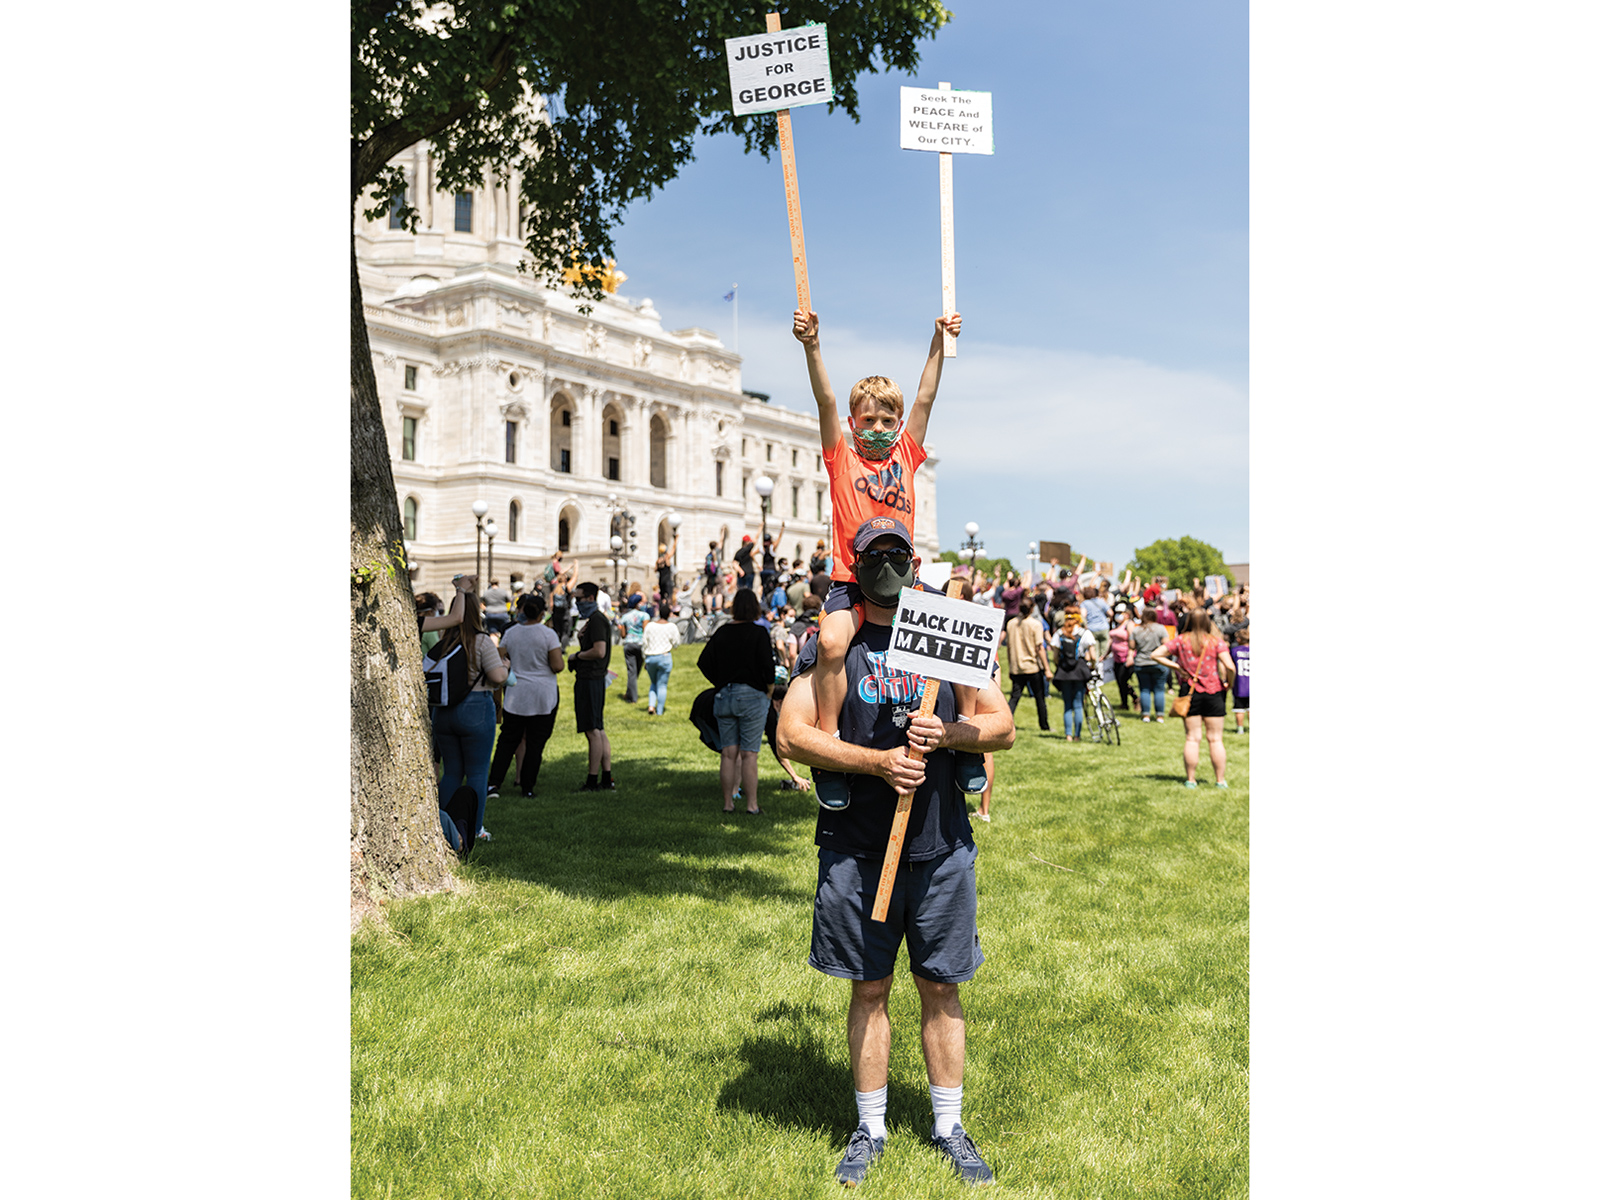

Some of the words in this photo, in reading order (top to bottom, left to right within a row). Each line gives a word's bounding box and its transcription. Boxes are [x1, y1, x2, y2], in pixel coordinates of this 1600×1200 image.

[735, 35, 820, 61] JUSTICE
[766, 63, 794, 76] FOR
[739, 78, 826, 104] GEORGE
[921, 94, 947, 103] Seek
[951, 96, 971, 104] The
[913, 106, 955, 117] PEACE
[959, 110, 979, 118] And
[909, 120, 968, 132] WELFARE
[918, 136, 937, 144] Our
[854, 477, 912, 514] adidas
[899, 607, 949, 633] BLACK
[951, 619, 994, 642] LIVES
[896, 631, 989, 667] MATTER
